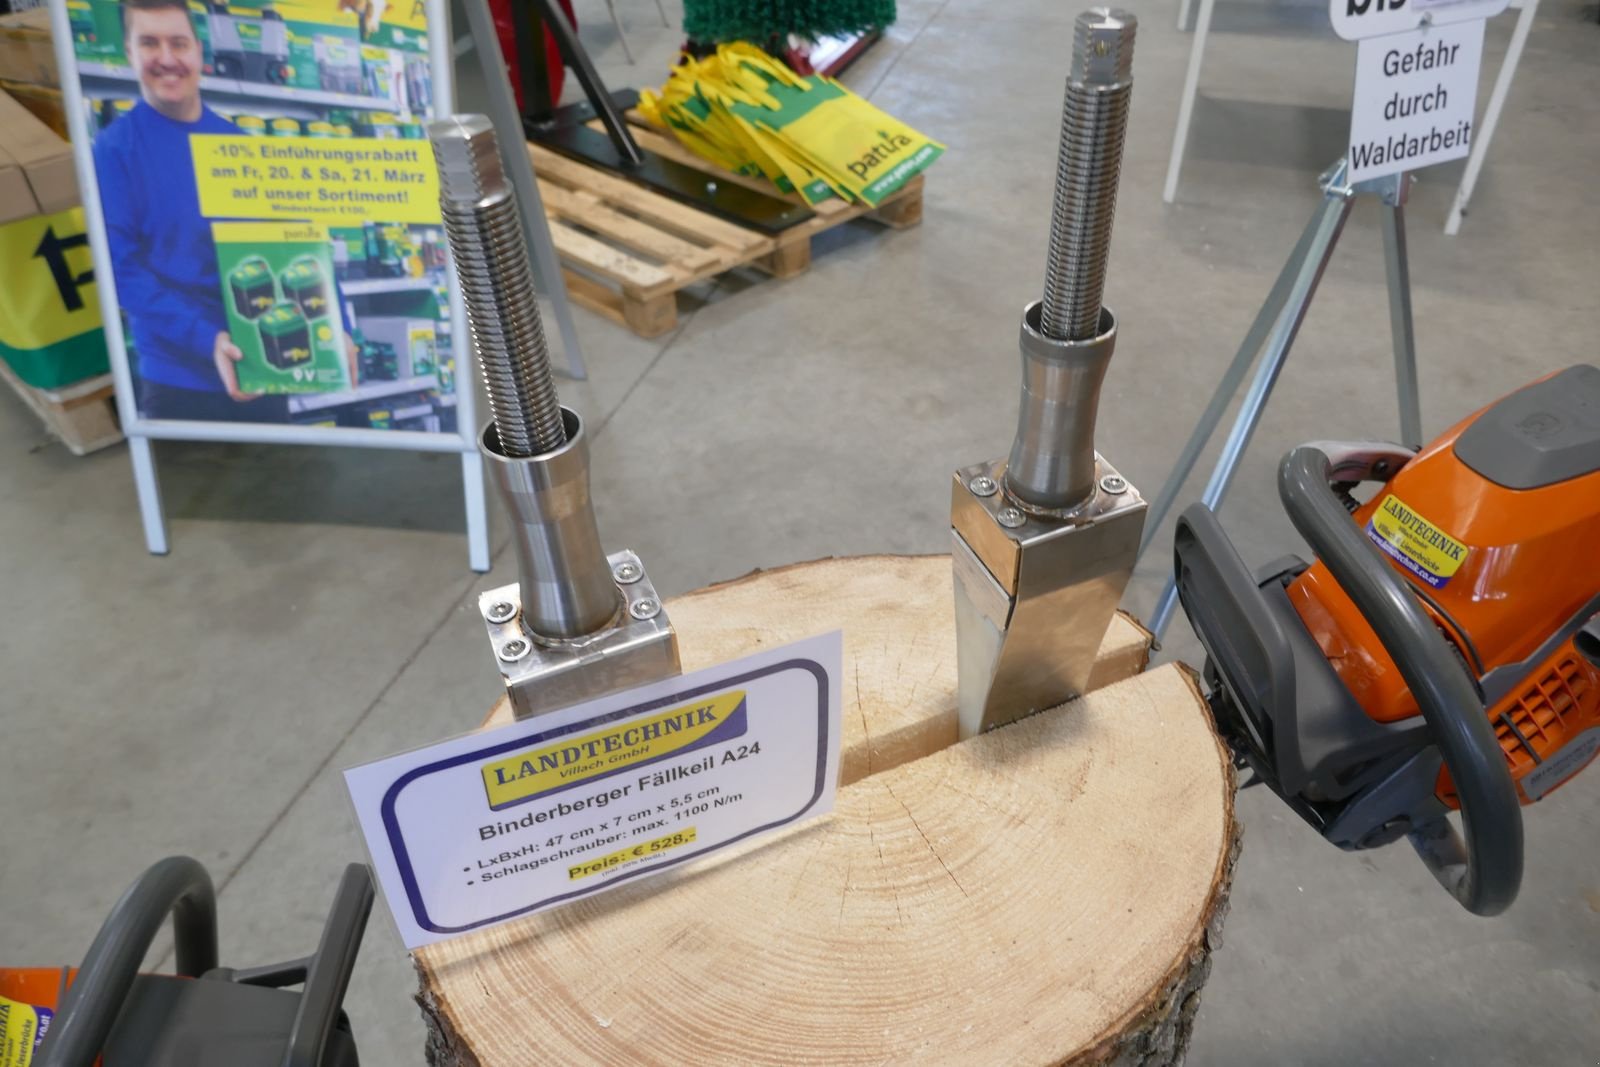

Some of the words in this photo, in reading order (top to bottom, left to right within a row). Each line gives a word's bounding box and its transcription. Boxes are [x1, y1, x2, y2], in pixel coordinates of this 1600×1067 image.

[1383, 40, 1460, 77] Gefahr
[1384, 84, 1448, 121] durch
[213, 144, 255, 159] -10%
[260, 144, 418, 164] Einführungsrabatt
[847, 131, 912, 181] patura
[1351, 120, 1471, 170] Waldarbeit
[211, 167, 237, 178] am
[242, 165, 263, 181] Fr,
[268, 166, 294, 179] 20.
[301, 166, 313, 179] &
[319, 166, 347, 182] Sa,
[353, 167, 378, 182] 21.
[384, 168, 426, 184] März
[232, 186, 259, 199] auf
[264, 189, 312, 201] unser
[318, 188, 409, 204] Sortiment!
[1383, 497, 1465, 560] LANDTECHNIK
[494, 704, 717, 785] LANDTECHNIK
[560, 759, 604, 778] Villach
[608, 745, 650, 764] GmbH
[478, 784, 632, 841] Binderberger
[638, 756, 715, 791] Fällkeil
[721, 741, 762, 765] A24
[477, 843, 541, 869] LxBxH:
[545, 834, 564, 848] 47
[570, 827, 595, 841] cm
[600, 822, 609, 832] x
[613, 816, 622, 827] 7
[628, 808, 652, 822] cm
[656, 804, 665, 813] x
[697, 786, 720, 799] cm
[481, 831, 627, 883] Schlagschrauber:
[632, 819, 669, 836] max.
[674, 803, 709, 821] 1100
[714, 793, 743, 808] N/m
[568, 854, 625, 879] Preis:
[632, 846, 644, 856] €
[650, 833, 696, 852] 528,-
